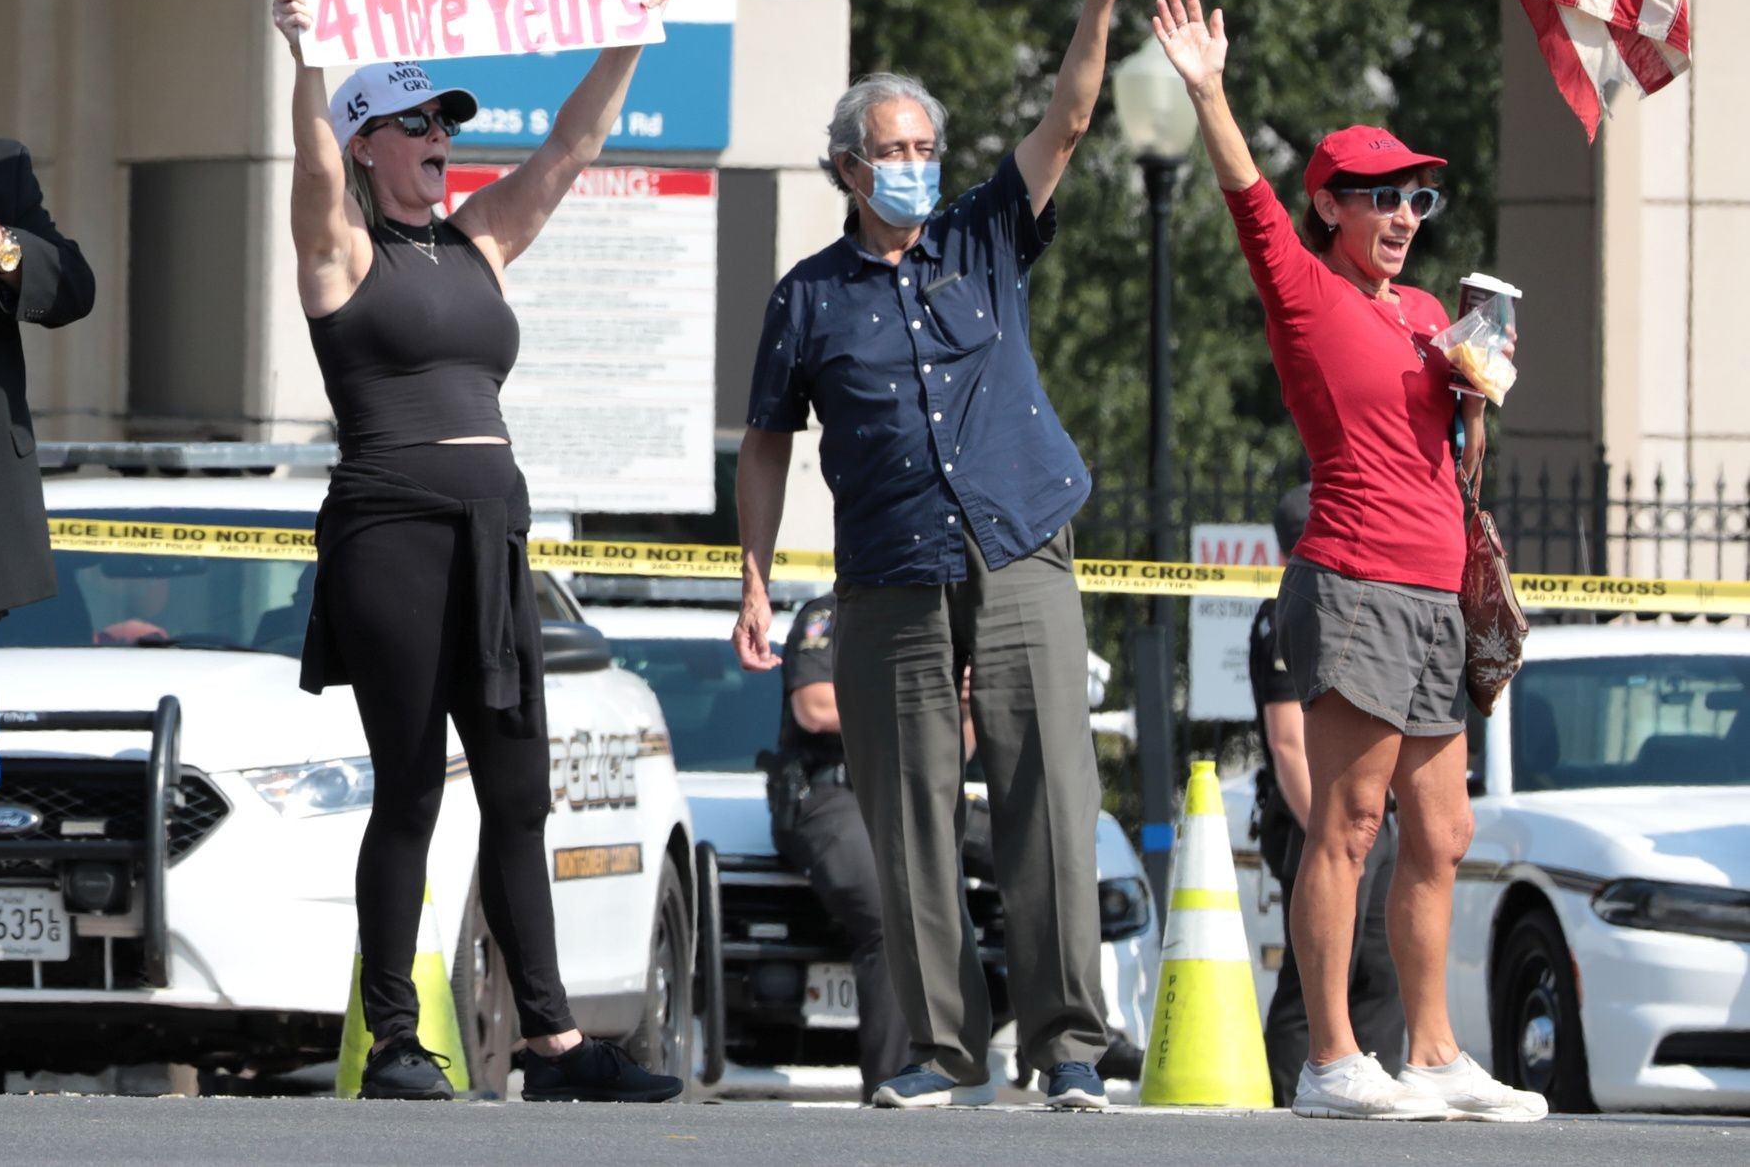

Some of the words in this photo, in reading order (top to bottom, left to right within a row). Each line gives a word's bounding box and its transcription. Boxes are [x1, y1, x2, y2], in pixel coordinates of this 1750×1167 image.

[388, 67, 428, 85] AMER
[403, 80, 432, 92] GRE
[346, 93, 369, 123] 45
[108, 524, 164, 540] LINE
[172, 527, 206, 542] DO
[215, 529, 266, 544] NOT
[274, 532, 317, 547] CRO
[538, 544, 596, 558] LINE
[603, 545, 637, 559] DO
[646, 547, 696, 562] NOT
[1081, 563, 1132, 577] NOT
[1141, 566, 1226, 581] CROSS
[1521, 578, 1573, 592] NOT
[1582, 580, 1667, 596] CROSS
[1158, 974, 1177, 1070] POLICE
